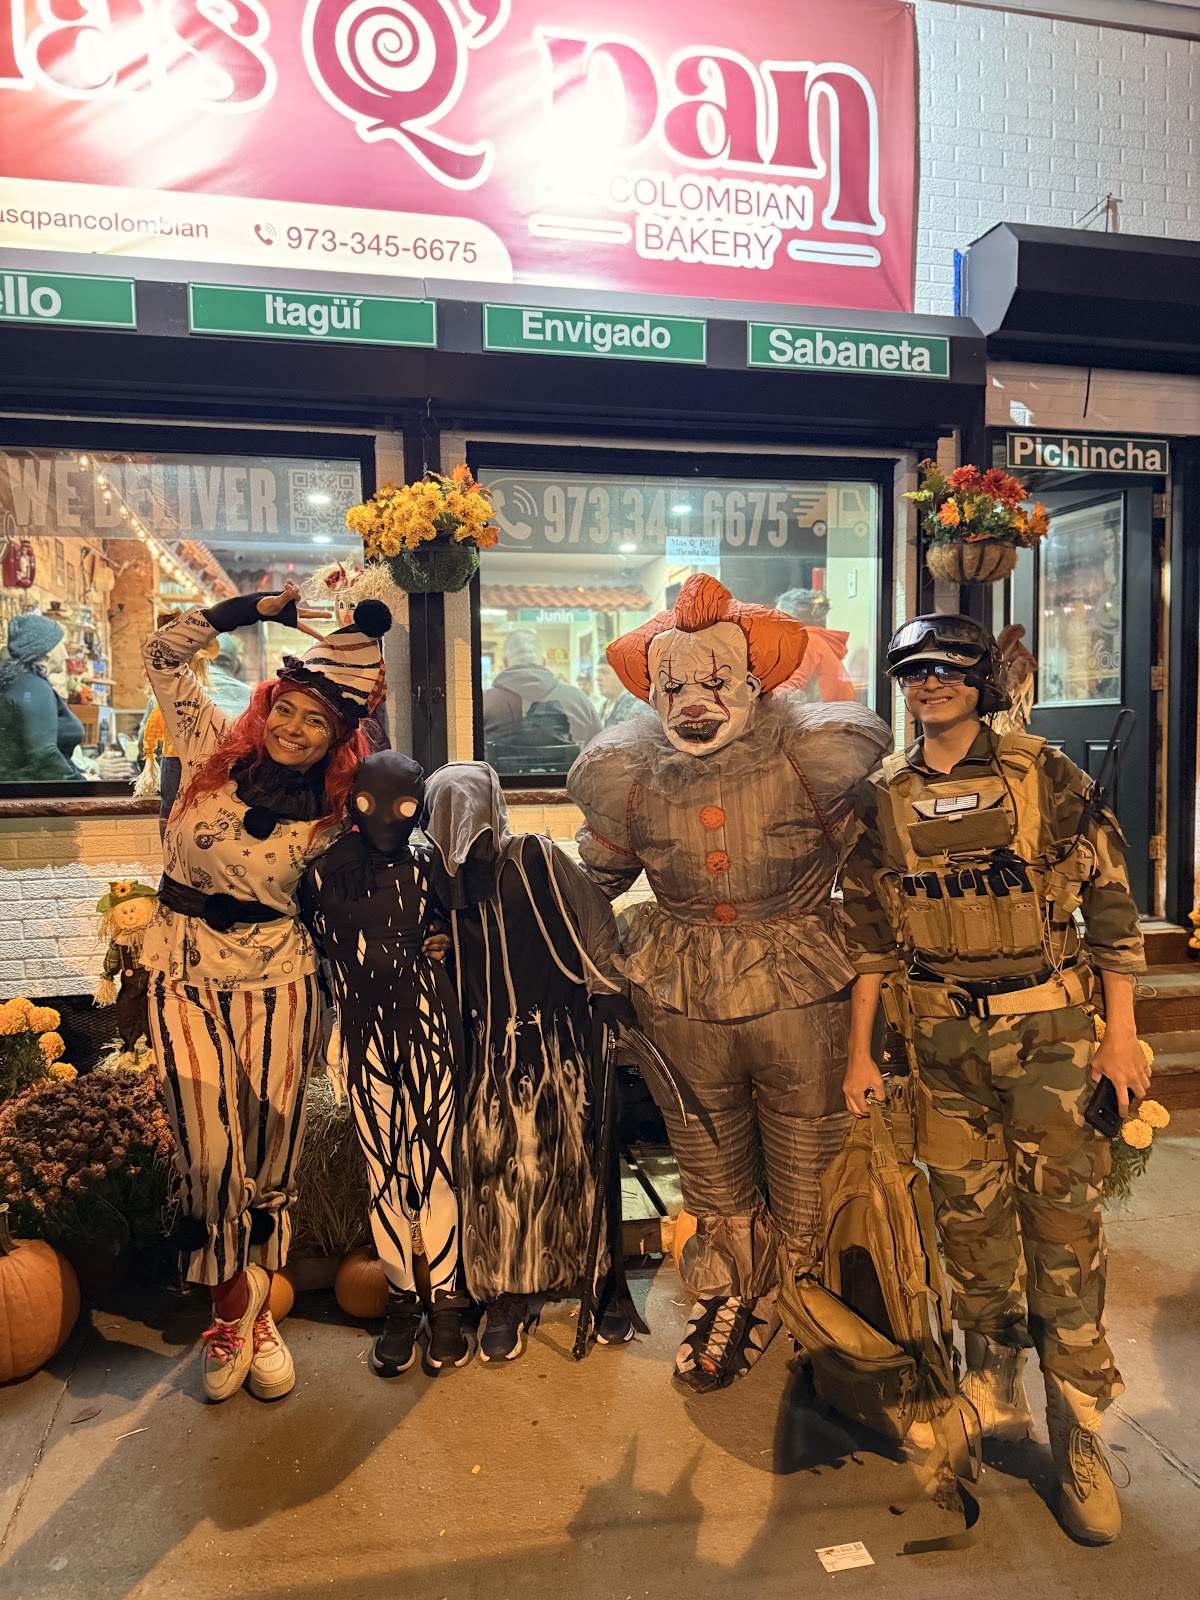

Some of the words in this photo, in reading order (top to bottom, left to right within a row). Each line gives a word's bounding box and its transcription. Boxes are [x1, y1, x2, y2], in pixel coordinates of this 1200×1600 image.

[609, 175, 806, 222] COLOMBIAN
[0, 208, 209, 238] sqpancolombian
[644, 223, 774, 261] BAKERY
[286, 226, 478, 264] 973-345-6675
[0, 275, 62, 317] llo
[265, 294, 364, 335] Itagüí
[521, 311, 671, 352] Envigado
[768, 328, 931, 372] Sabaneta
[1014, 437, 1162, 471] Pichincha
[7, 458, 82, 527] WE
[94, 462, 279, 534] DELIVER
[543, 485, 788, 547] 973.3456675
